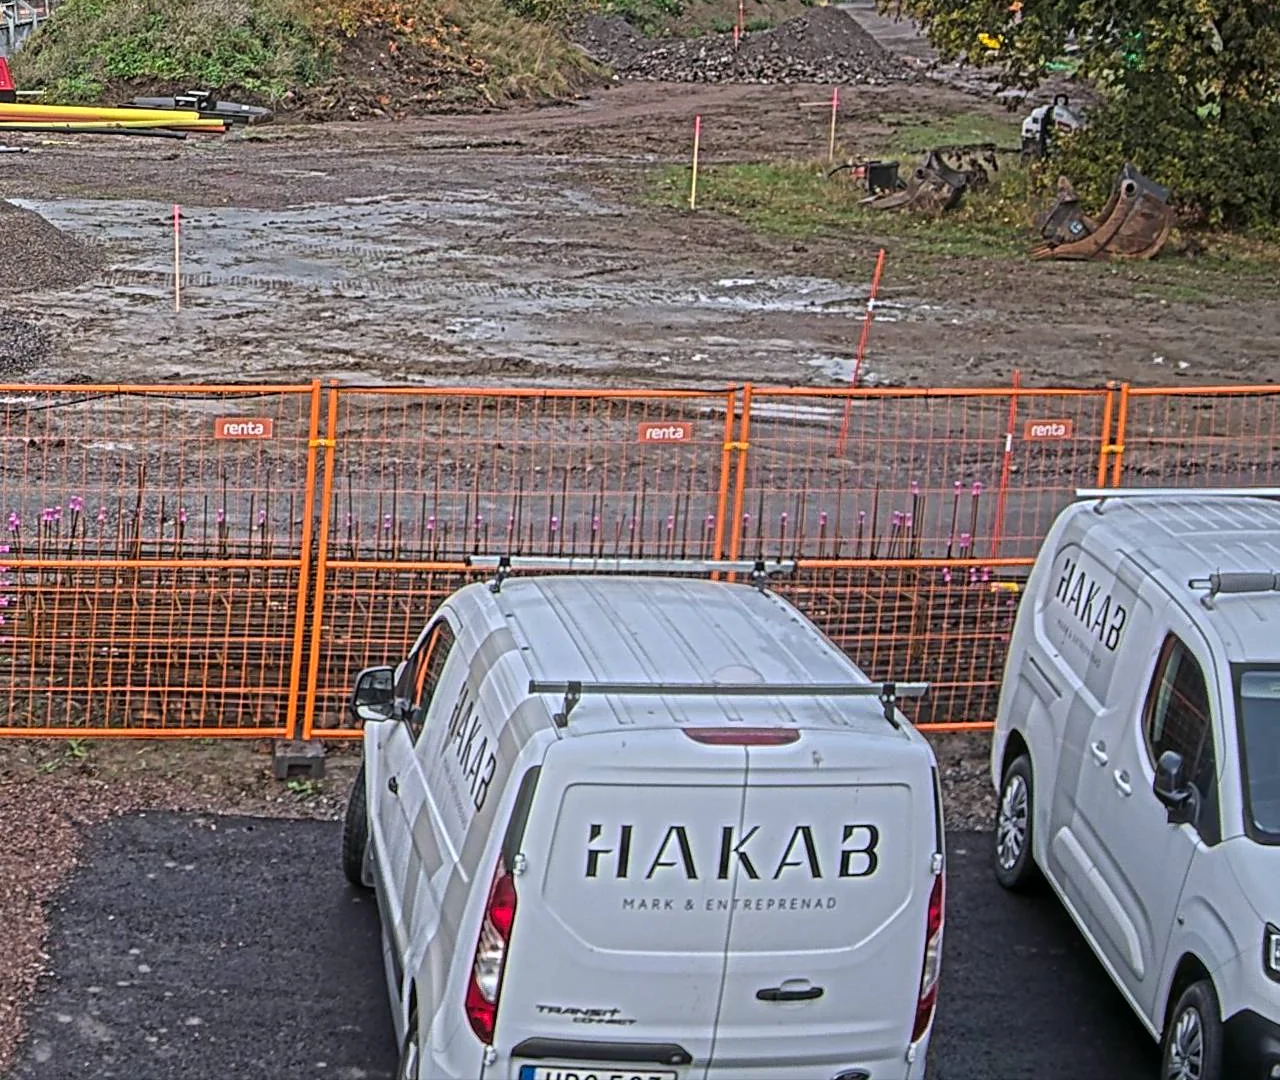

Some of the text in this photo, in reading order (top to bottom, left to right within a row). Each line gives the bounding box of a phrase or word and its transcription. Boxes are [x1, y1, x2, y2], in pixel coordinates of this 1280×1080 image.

[223, 421, 264, 435] renta
[645, 425, 684, 439] renta
[1031, 423, 1066, 437] renta
[1055, 558, 1126, 652] HAKAB
[448, 681, 497, 813] HAKAB
[585, 824, 880, 880] HAKAB
[622, 897, 837, 911] MARK & ENTREPRENAD
